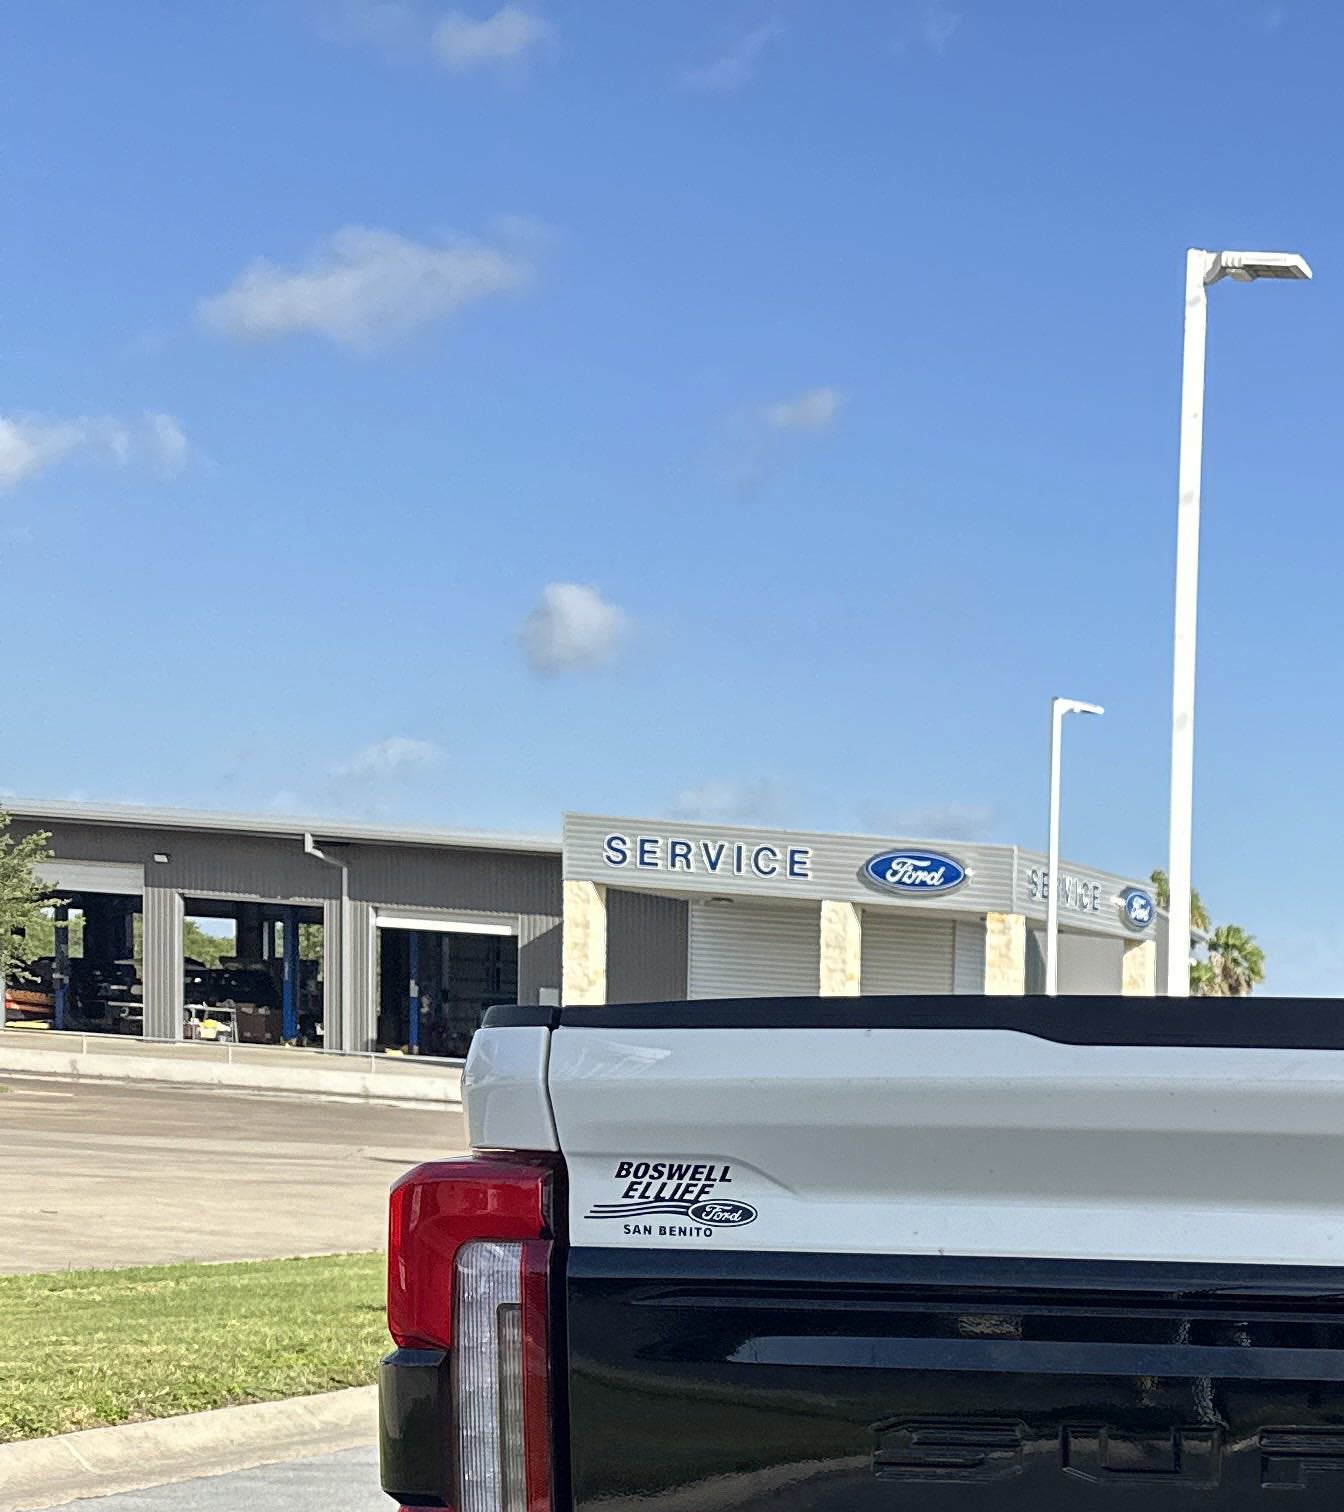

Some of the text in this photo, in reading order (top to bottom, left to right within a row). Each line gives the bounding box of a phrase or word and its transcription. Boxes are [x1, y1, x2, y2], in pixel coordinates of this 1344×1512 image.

[603, 832, 813, 881] SERVICE
[885, 857, 945, 886] Ford
[1028, 867, 1101, 913] SEVICE
[615, 1161, 733, 1183] BOSWELL
[621, 1180, 715, 1201] ELLIFF
[701, 1204, 742, 1222] Ford
[623, 1224, 713, 1238] SAN BENITO
